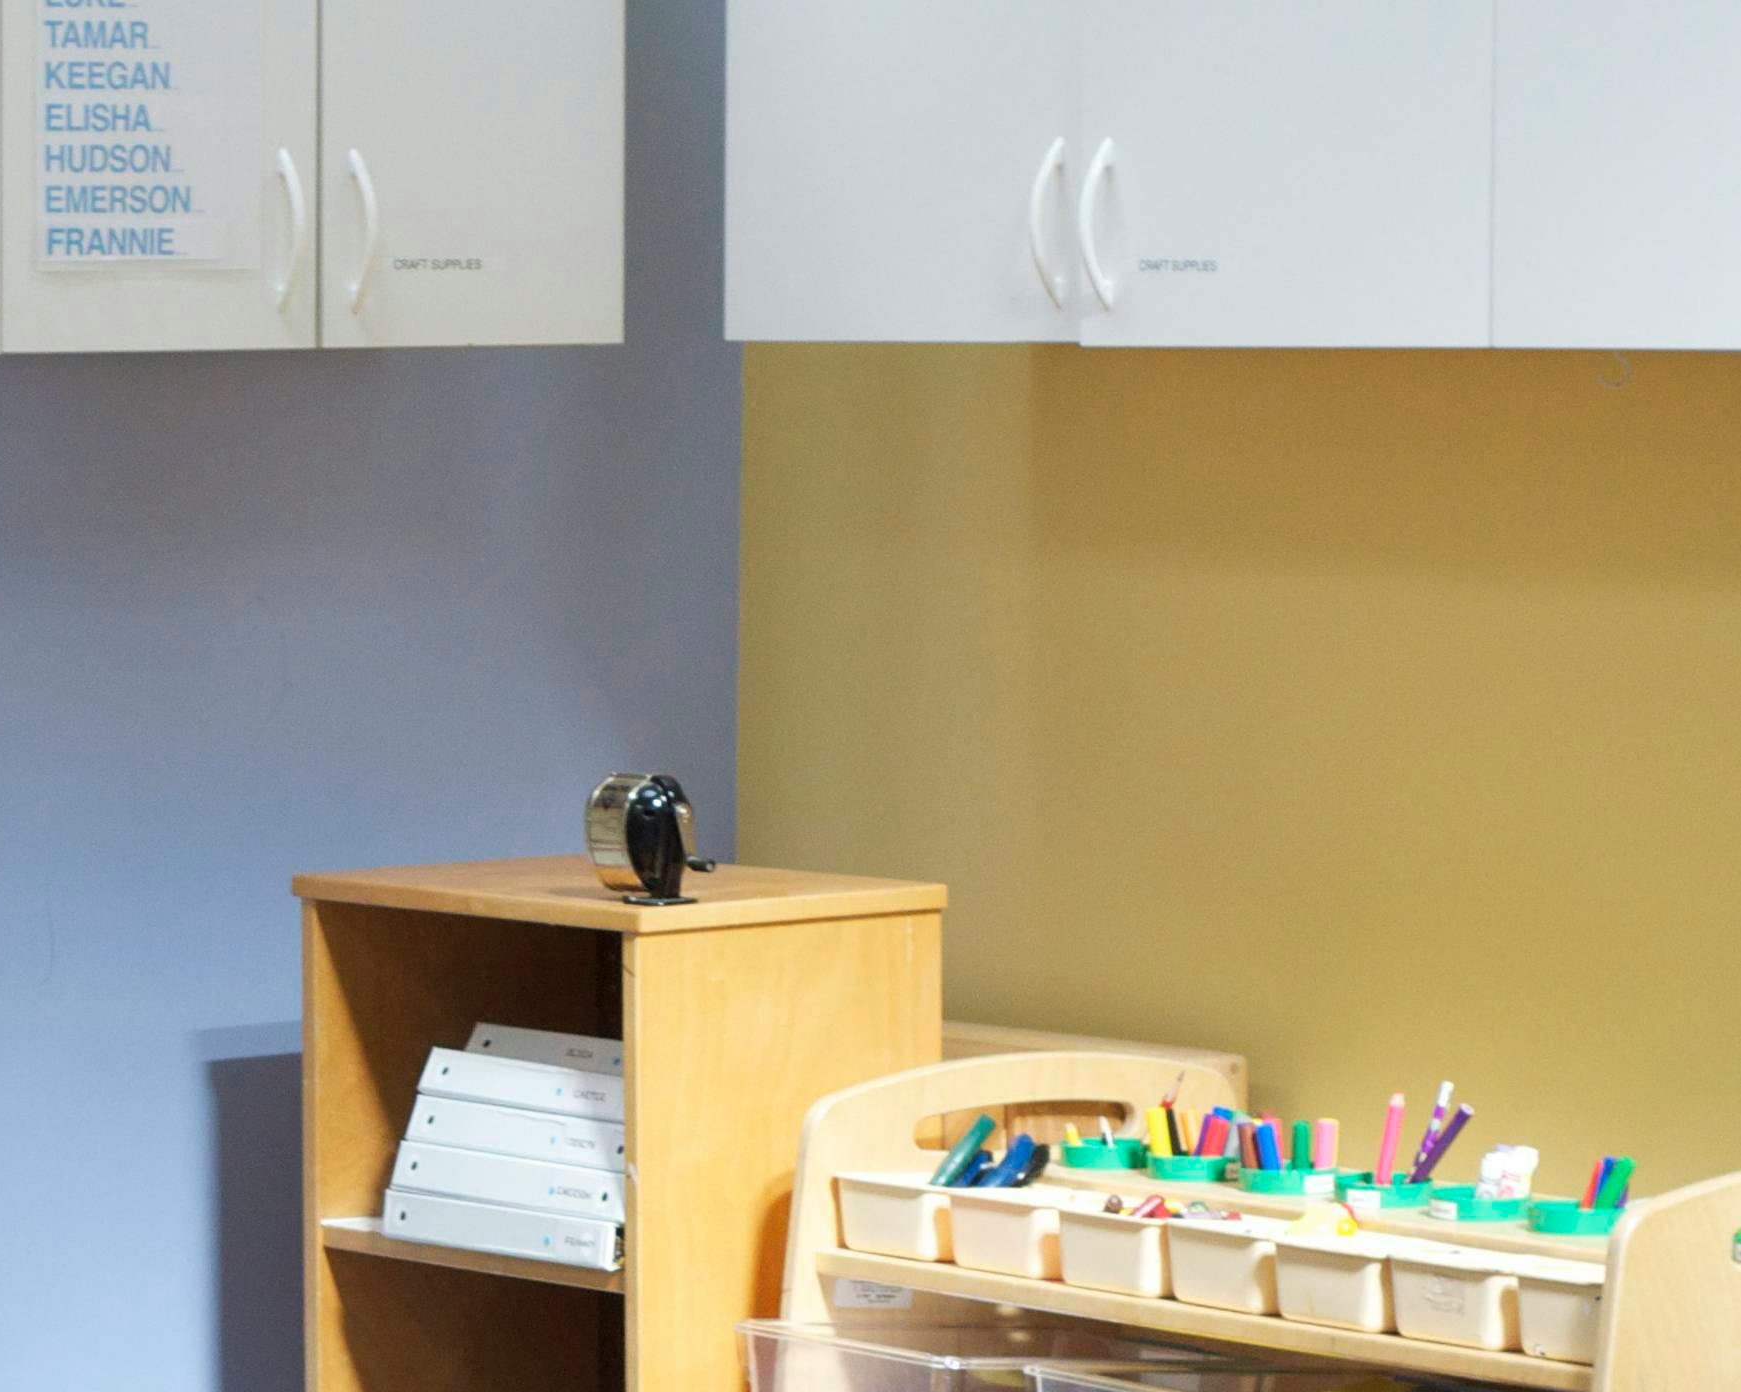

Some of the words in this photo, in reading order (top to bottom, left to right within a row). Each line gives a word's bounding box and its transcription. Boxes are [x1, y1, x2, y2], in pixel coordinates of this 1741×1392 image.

[44, 17, 149, 50] TAMAR
[44, 58, 172, 92] KEEGAN
[44, 100, 152, 134] ELISHA
[44, 142, 172, 176] HUDSON
[44, 183, 192, 216] EMERSON
[45, 224, 174, 257] FRANNIE
[393, 257, 428, 271] CRAFT
[430, 257, 483, 271] SUPPLIES
